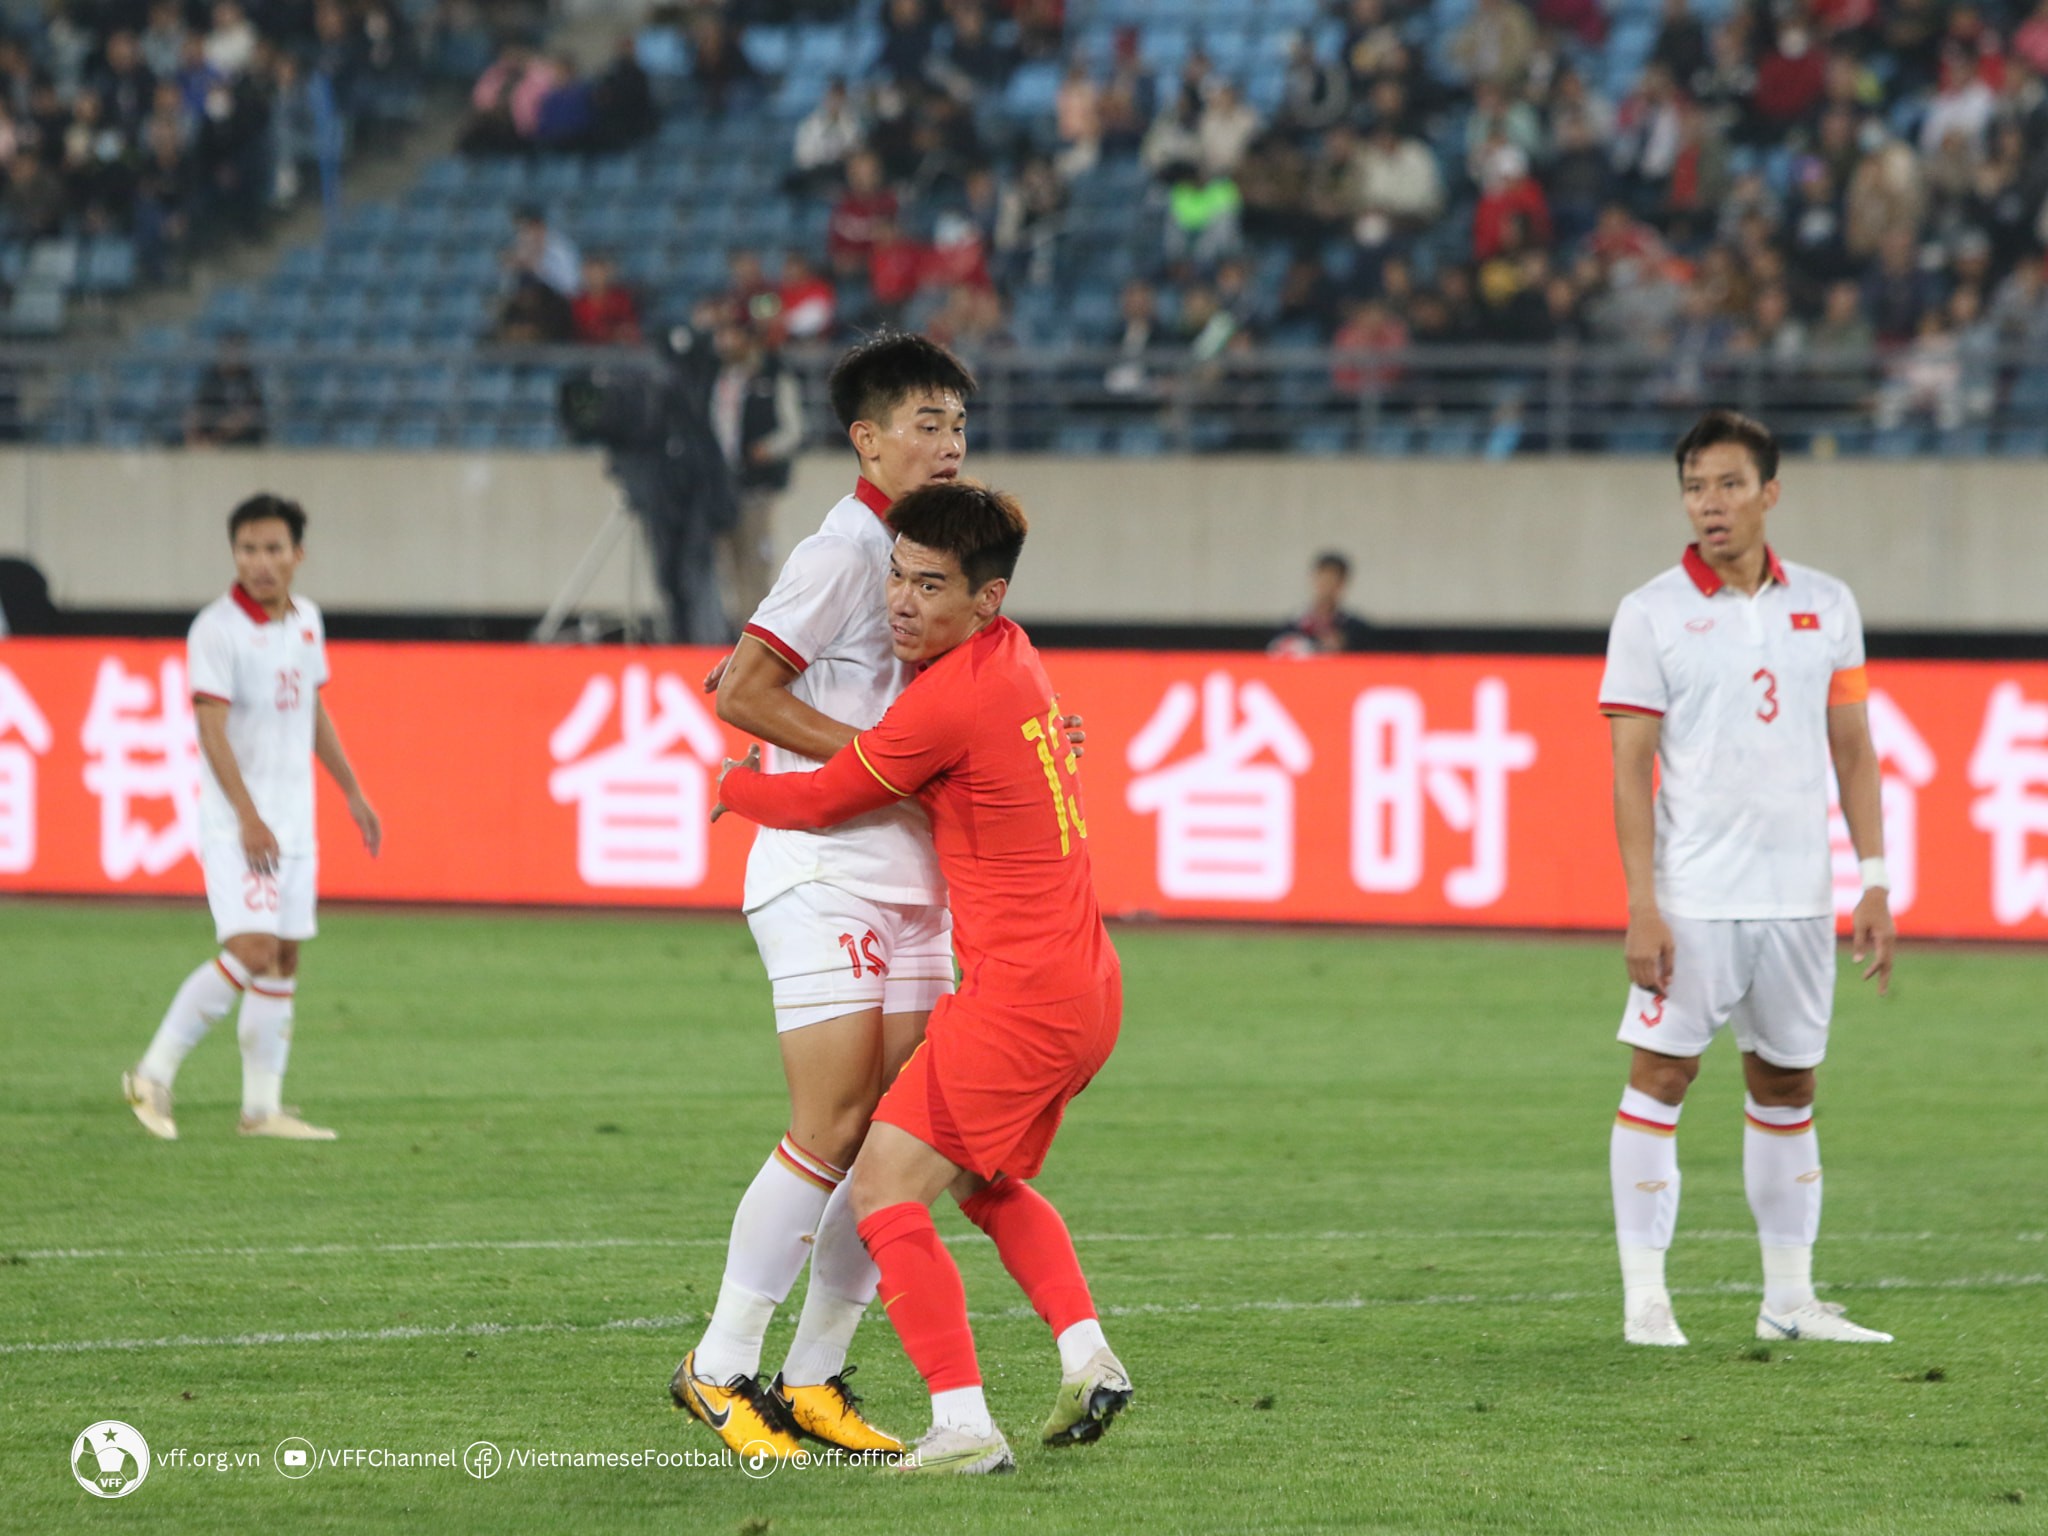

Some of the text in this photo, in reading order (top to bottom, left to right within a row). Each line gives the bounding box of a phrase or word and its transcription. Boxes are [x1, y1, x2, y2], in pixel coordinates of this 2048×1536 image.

[0, 656, 202, 881] 钱
[1126, 671, 1537, 909] 省时
[1752, 668, 1780, 724] 3
